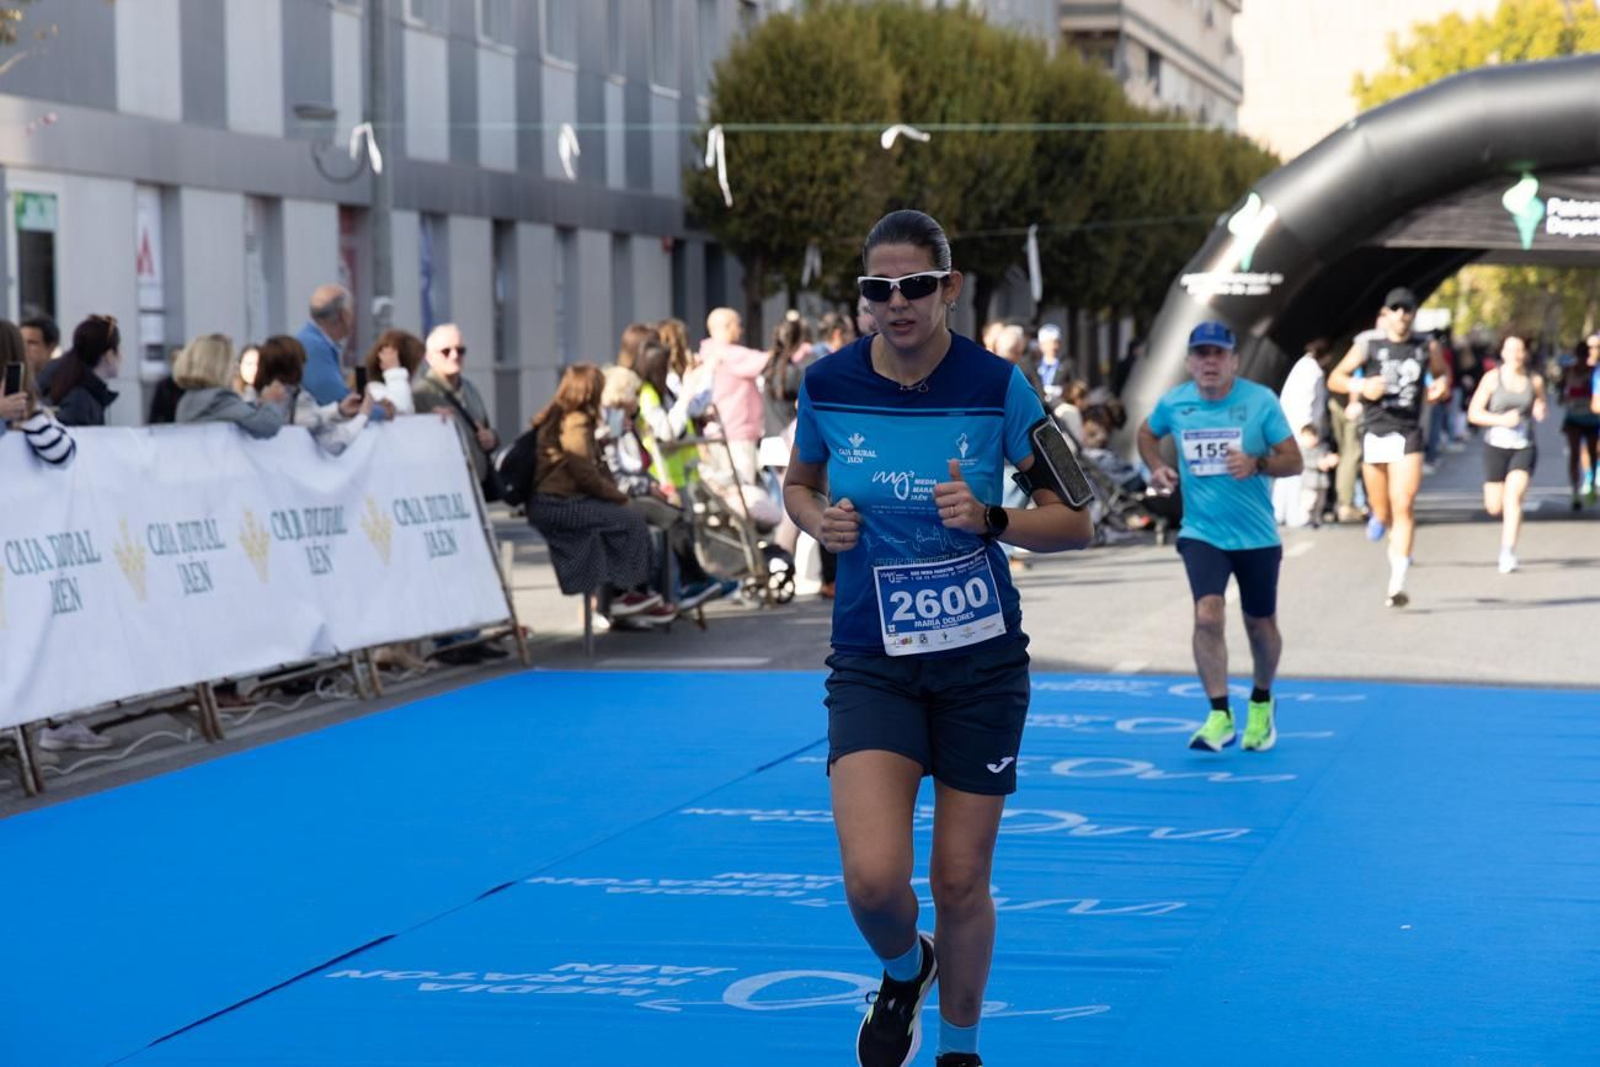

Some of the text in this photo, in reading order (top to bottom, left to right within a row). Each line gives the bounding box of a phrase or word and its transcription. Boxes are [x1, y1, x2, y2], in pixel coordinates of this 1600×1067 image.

[1194, 442, 1231, 458] 155
[4, 538, 54, 576] CAJA
[889, 577, 989, 621] 2600
[942, 611, 975, 625] DOLORES
[418, 982, 656, 996] MEDIA
